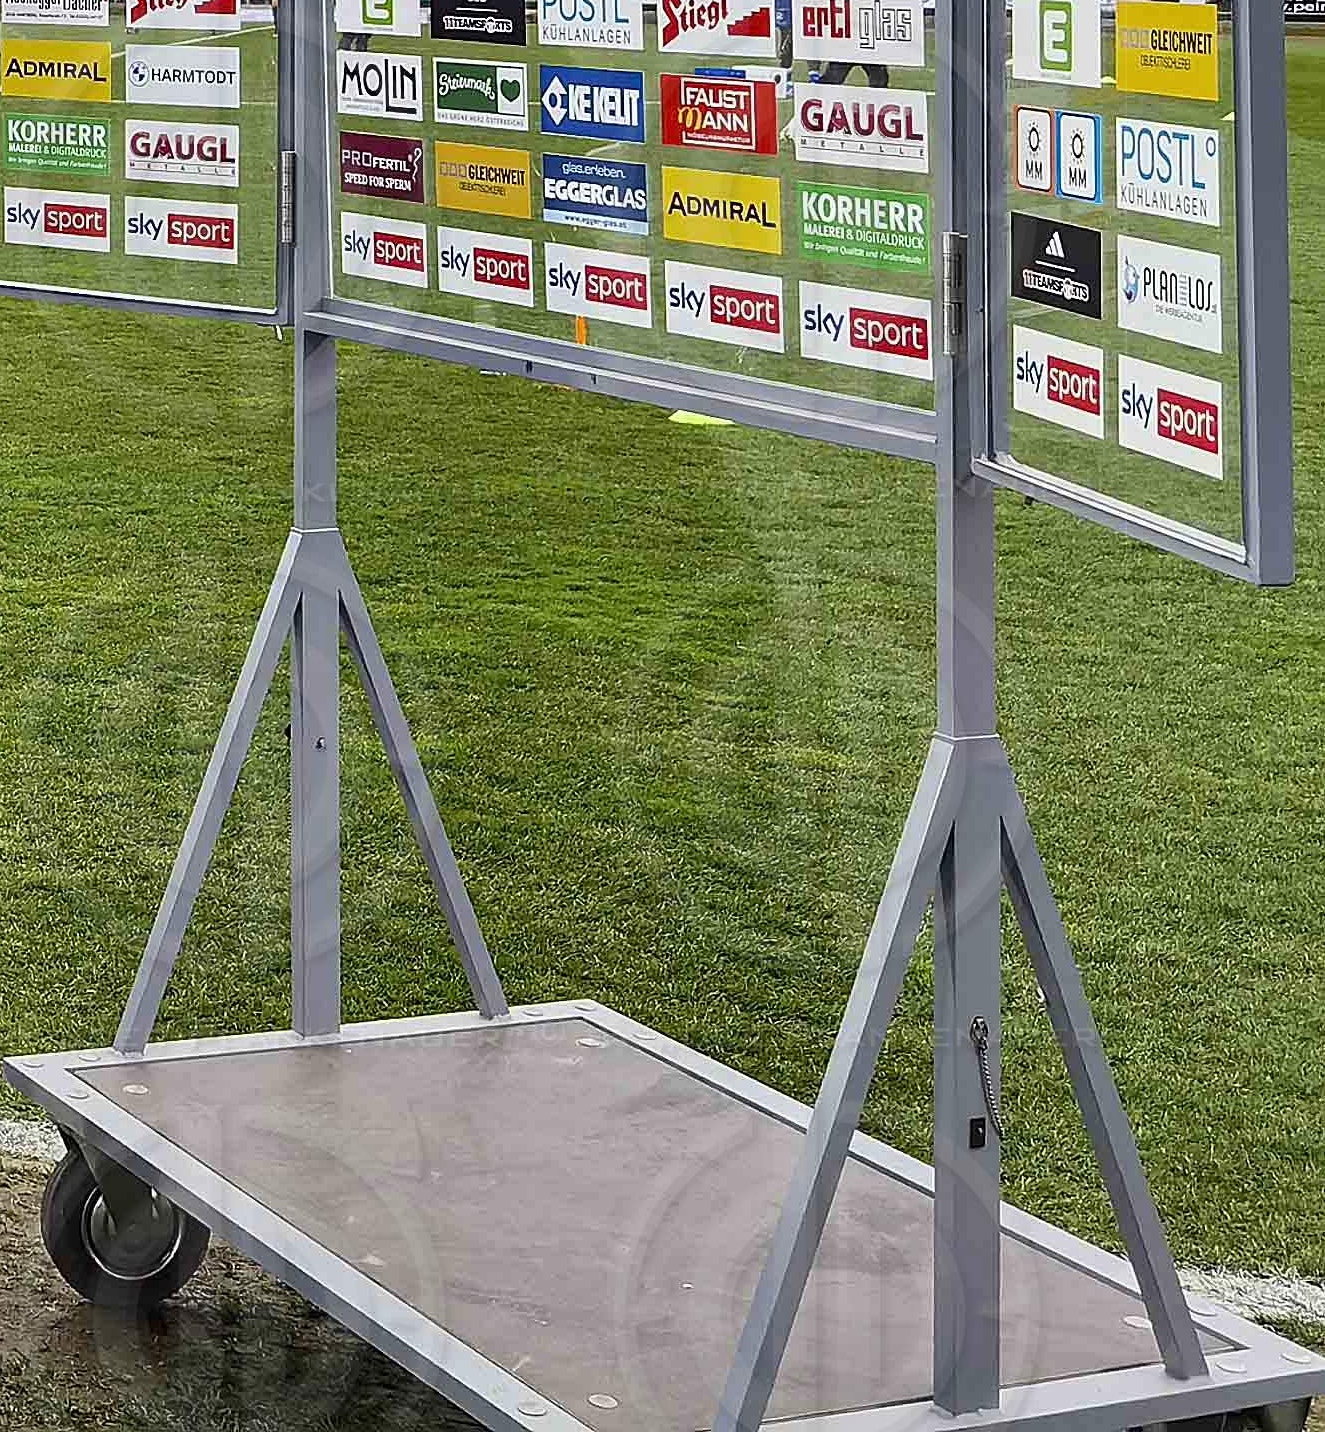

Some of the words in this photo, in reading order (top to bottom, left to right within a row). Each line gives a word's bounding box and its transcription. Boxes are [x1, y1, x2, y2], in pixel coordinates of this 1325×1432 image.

[542, 24, 631, 44] KÜHLANLAGEN
[803, 0, 851, 39] ertl
[858, 0, 912, 50] glas
[1151, 29, 1212, 55] GLEICHWEIT
[5, 57, 107, 82] ADMIRAL
[151, 69, 237, 85] HARMTODT
[686, 87, 749, 109] FAUST
[8, 120, 107, 147] KORHERR
[801, 99, 924, 141] GAUGL
[51, 145, 107, 159] DIGITALDRUCK
[130, 131, 236, 164] GAUGL
[344, 172, 368, 188] SPEED
[368, 175, 384, 190] FOR
[385, 177, 412, 193] SPERM
[468, 161, 526, 186] GLEICHWEIT
[544, 178, 647, 210] EGGERGLAS
[668, 192, 776, 228] ADMIRAL
[1120, 183, 1208, 217] KÜHLANLAGEN
[7, 203, 41, 230] sky
[47, 209, 104, 235] sport
[128, 213, 164, 240] sky
[170, 219, 231, 244] sport
[802, 191, 924, 234] KORHERR
[345, 230, 370, 261] sky
[376, 237, 422, 265] sport
[803, 223, 845, 240] MALEREI
[846, 230, 854, 241] &
[856, 231, 925, 249] DIGITALDRUCK
[441, 246, 470, 277] sky
[476, 252, 528, 283] sport
[549, 263, 581, 296] sky
[588, 271, 645, 304] sport
[670, 282, 705, 317] sky
[714, 295, 775, 326] sport
[804, 304, 845, 341] sky
[853, 317, 924, 349] sport
[1016, 351, 1043, 393] sky
[1050, 368, 1097, 405] sport
[1121, 383, 1153, 429] sky
[1159, 401, 1216, 443] sport
